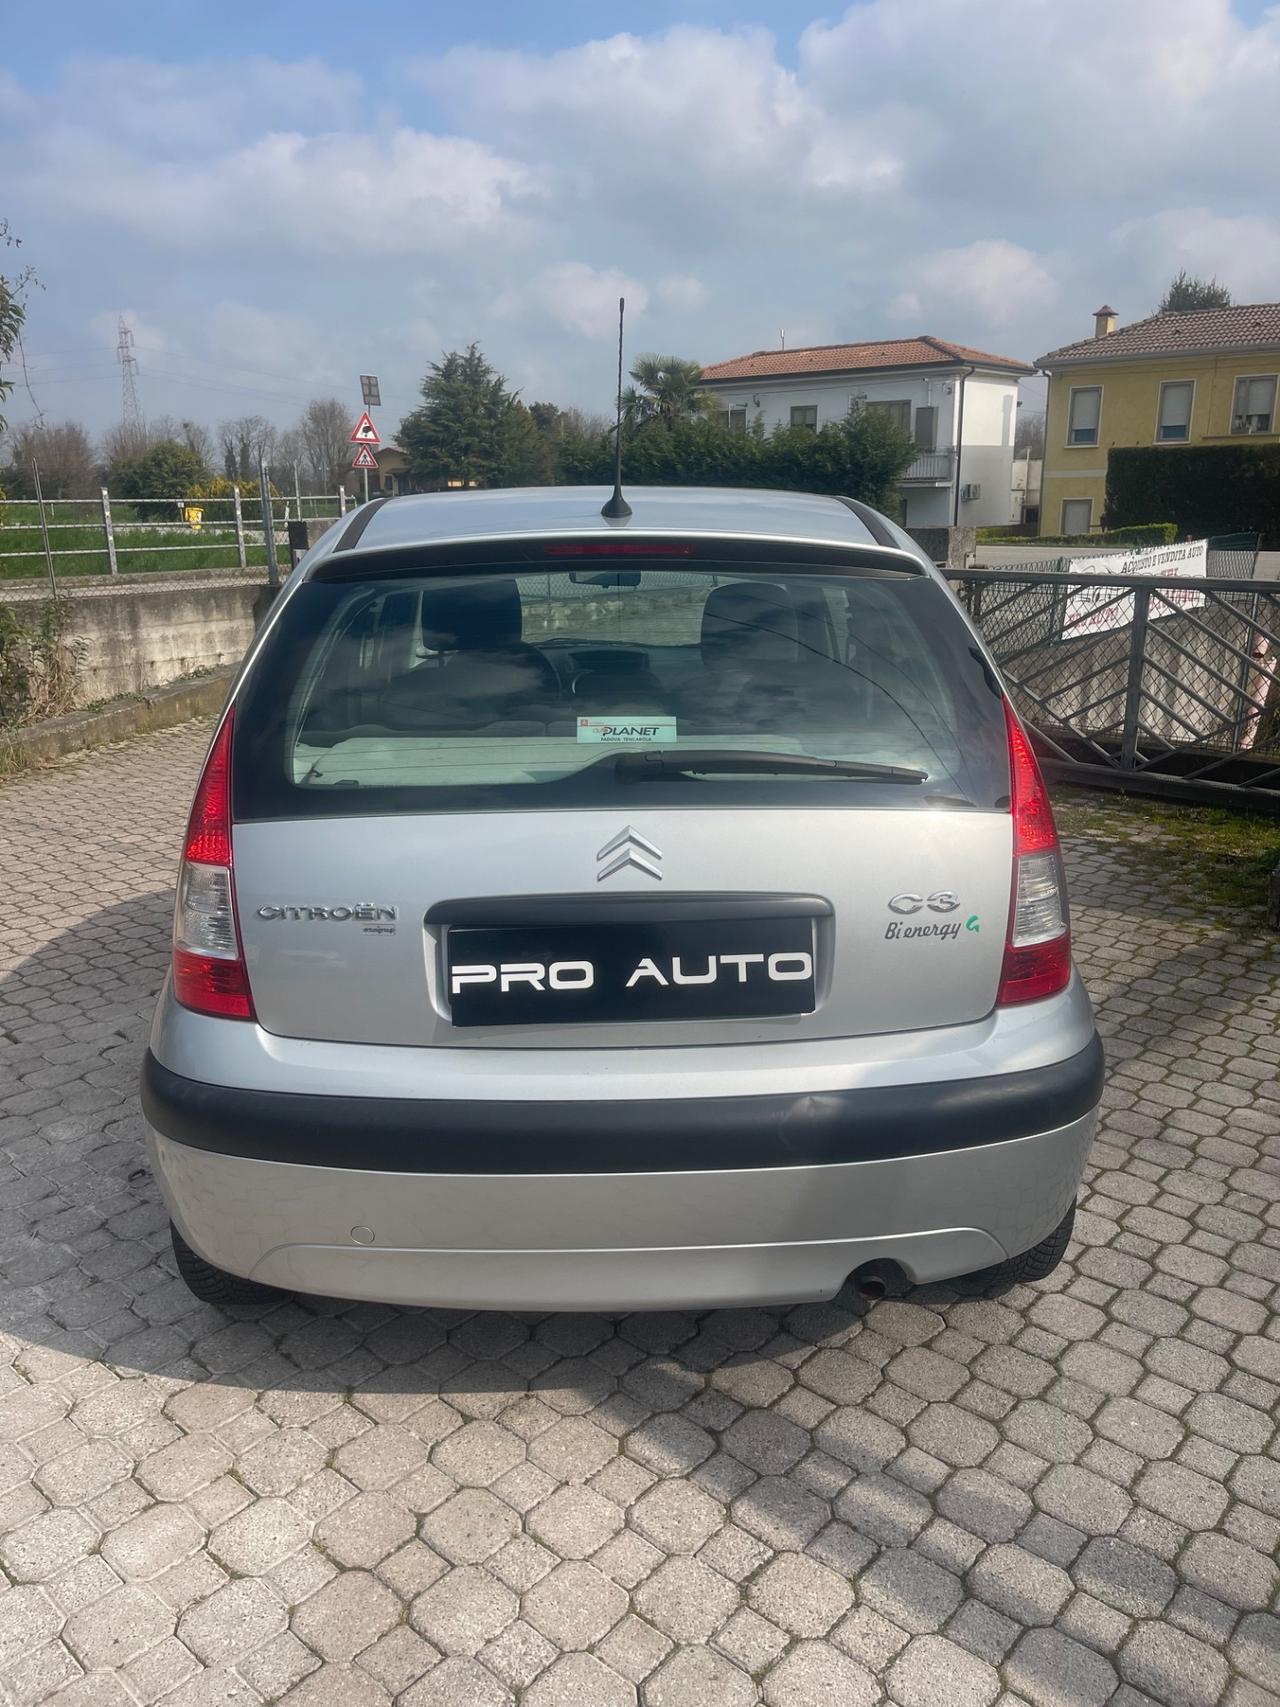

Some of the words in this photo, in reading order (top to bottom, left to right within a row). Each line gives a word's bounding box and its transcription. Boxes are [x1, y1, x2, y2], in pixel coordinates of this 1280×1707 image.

[1157, 548, 1186, 565] VENDITA
[1187, 545, 1204, 559] AUTO
[603, 726, 660, 737] PLANET
[257, 902, 398, 921] CITROËN
[888, 890, 960, 915] C3
[451, 960, 595, 995] PRO
[625, 951, 813, 988] AUTO
